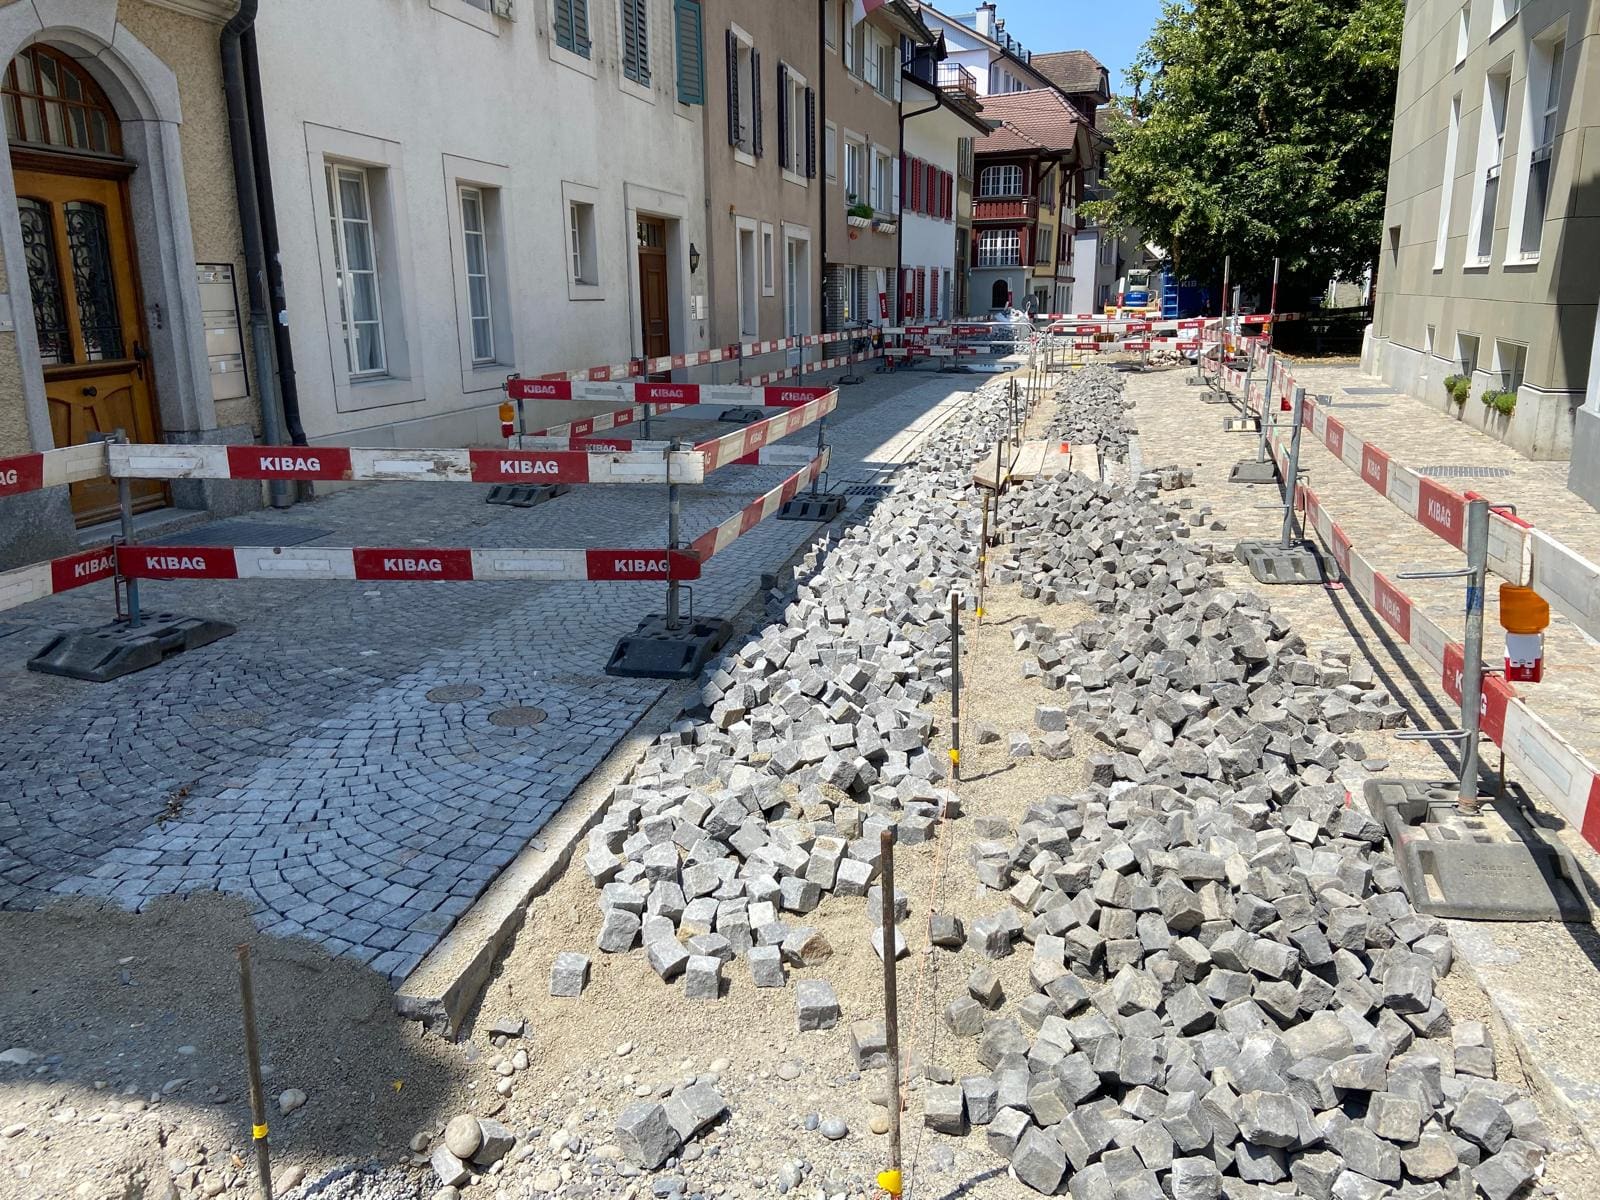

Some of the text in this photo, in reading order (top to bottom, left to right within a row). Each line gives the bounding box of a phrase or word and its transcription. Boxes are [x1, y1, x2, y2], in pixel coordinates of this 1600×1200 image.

[523, 384, 556, 394] KIBAG
[650, 388, 683, 398] KIBAG
[781, 391, 815, 401] KIBAG
[260, 456, 321, 472] KIBAG
[499, 459, 559, 474] KIBAG
[1366, 457, 1381, 481] KIBAG
[1428, 497, 1451, 529] KIBAG
[146, 556, 206, 570] KIBAG
[383, 557, 442, 573] KIBAG
[614, 559, 670, 572] KIBAG
[1381, 592, 1401, 625] KIBAG
